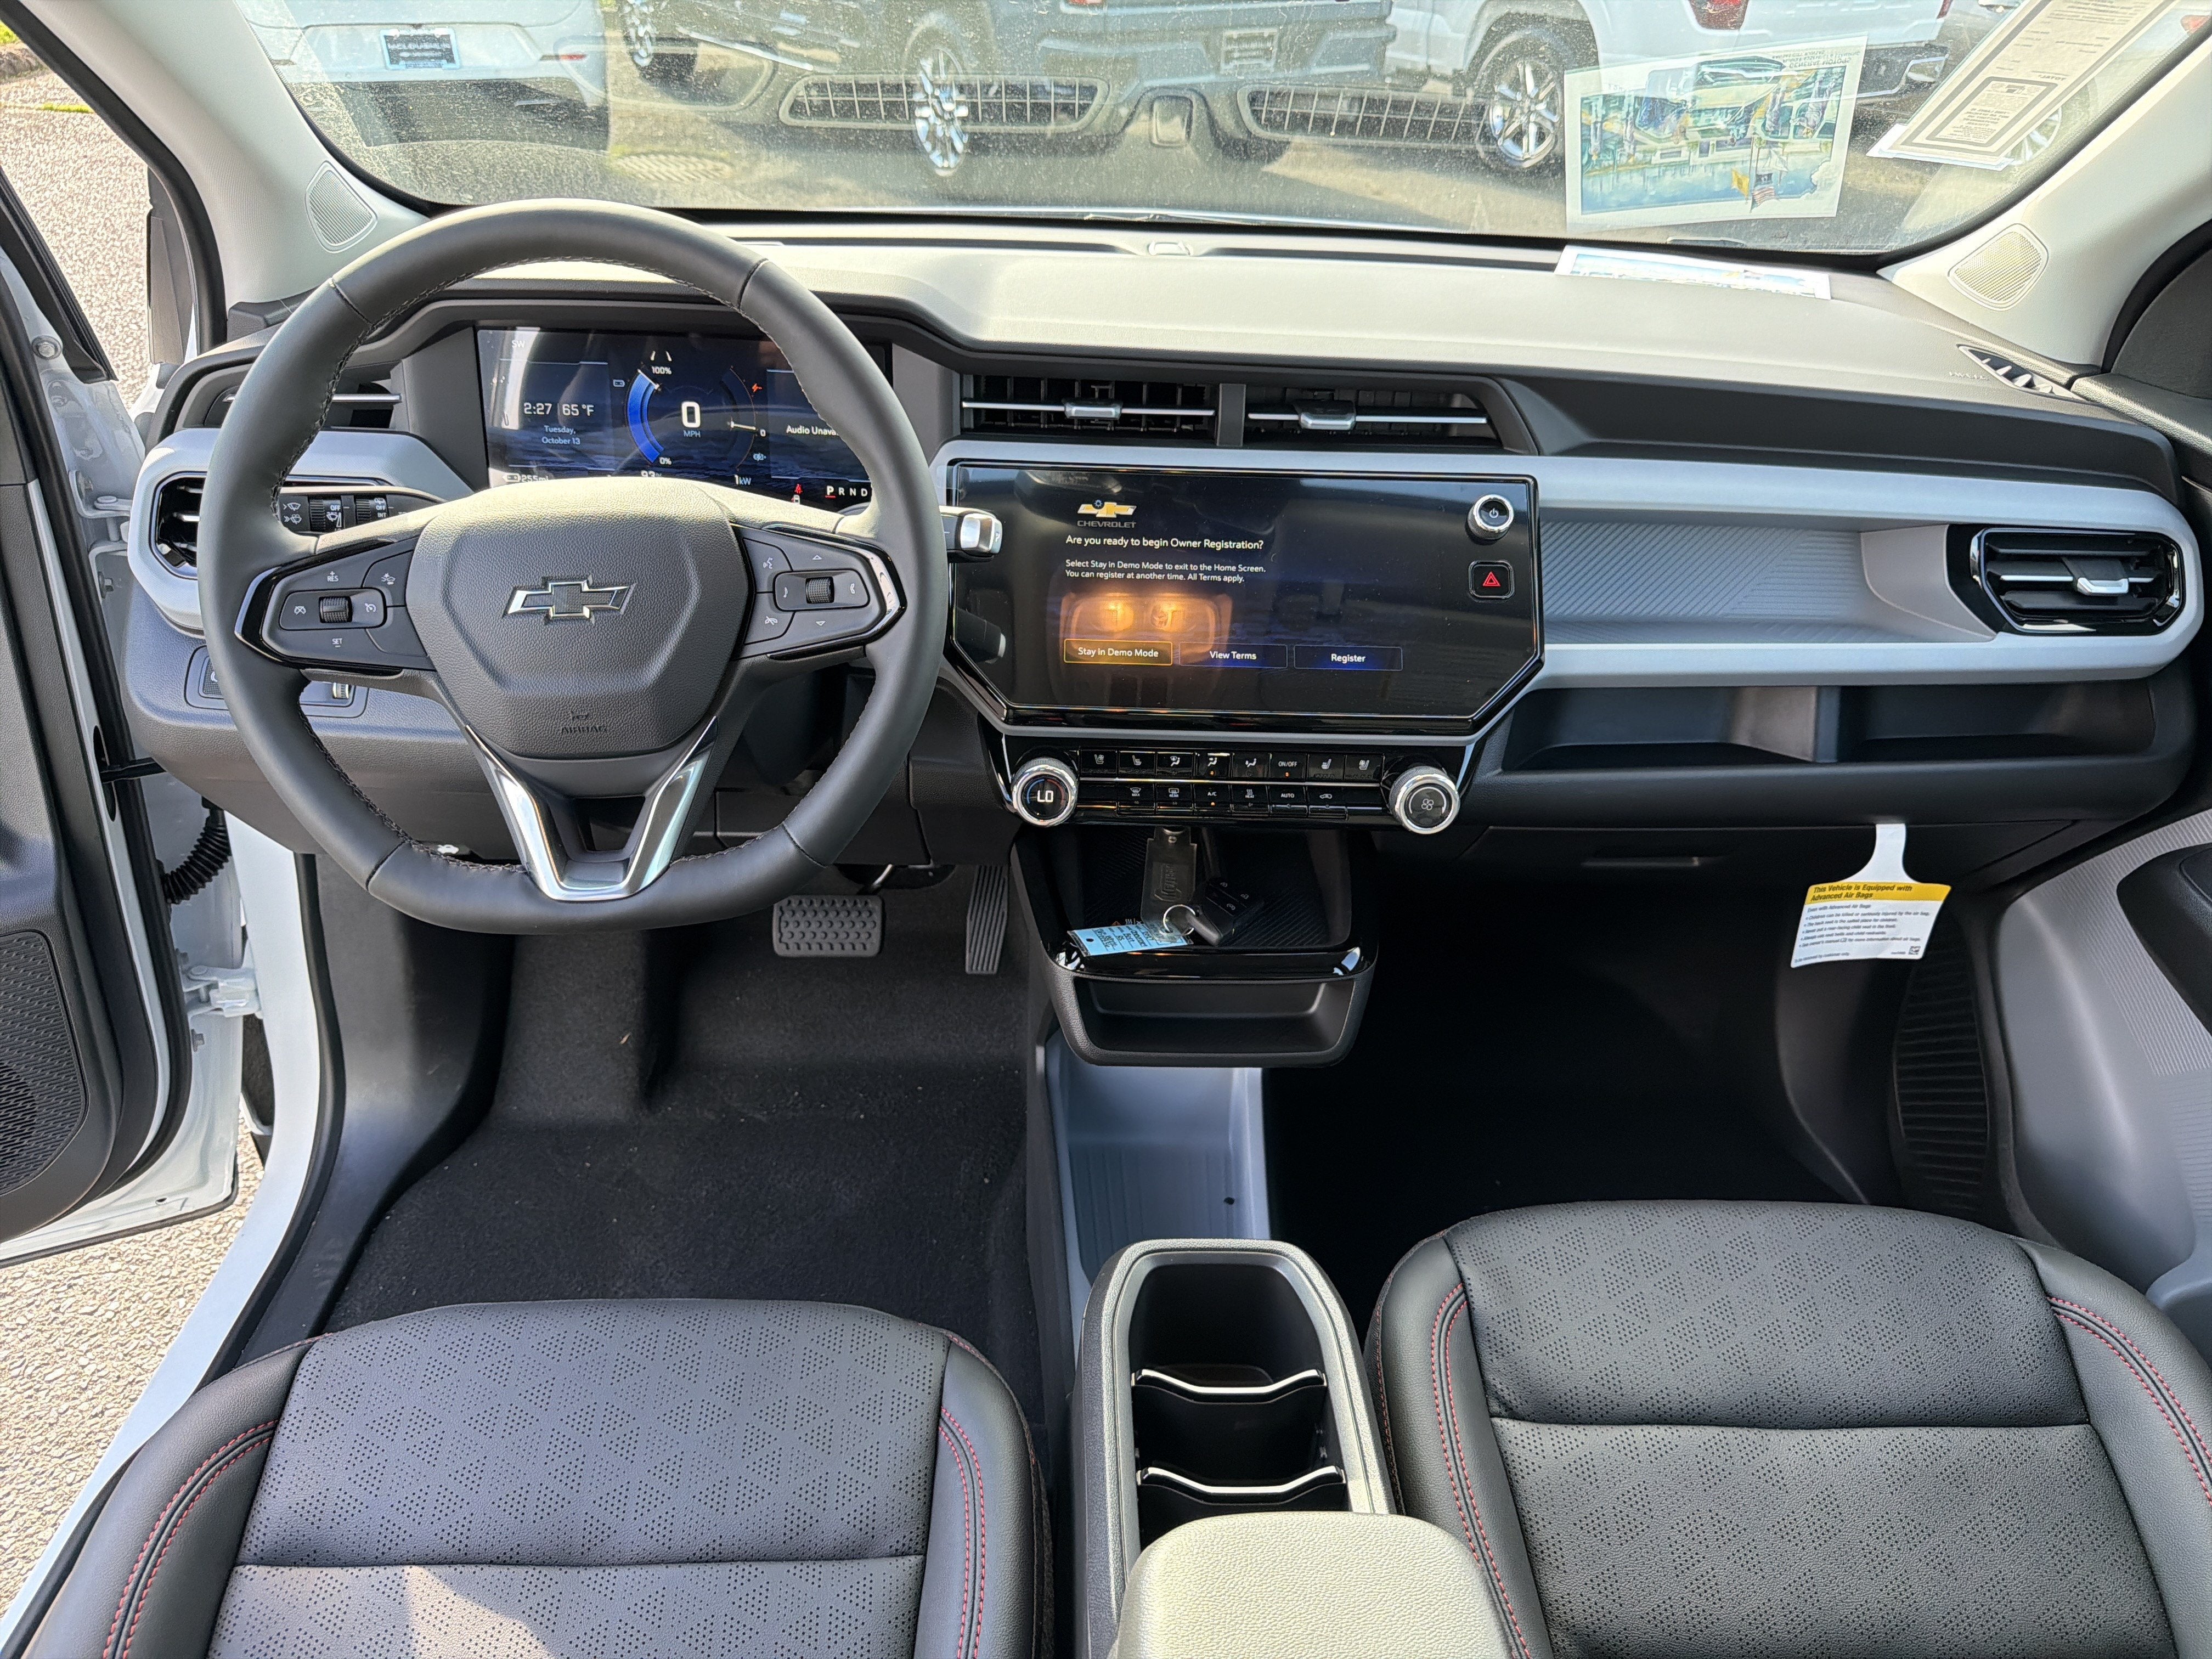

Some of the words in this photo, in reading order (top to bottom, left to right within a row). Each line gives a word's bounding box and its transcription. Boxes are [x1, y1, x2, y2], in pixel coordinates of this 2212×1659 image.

[511, 340, 525, 348] SW
[651, 366, 672, 375] 100%
[523, 402, 552, 415] 2:27
[562, 404, 579, 416] 65
[582, 404, 594, 416] °F
[681, 401, 701, 428] 0
[544, 425, 576, 435] Tuesday,
[684, 430, 701, 438] MPH
[786, 425, 810, 435] Audio
[541, 437, 571, 445] October
[659, 457, 672, 465] 0%
[826, 486, 834, 495] P
[838, 487, 845, 496] R
[850, 488, 856, 496] N
[861, 488, 868, 496] D
[1077, 520, 1137, 528] CHEVROLET
[1065, 535, 1082, 544] Are
[1084, 537, 1101, 546] you
[1103, 537, 1128, 548] ready
[1131, 538, 1141, 546] to
[1142, 537, 1169, 549] begin
[1170, 538, 1201, 548] Owner
[1204, 539, 1264, 550] Registration?
[1065, 560, 1089, 568] Select
[1091, 560, 1107, 569] Stay
[1117, 561, 1140, 569] Demo
[1142, 562, 1163, 570] Mode
[1238, 564, 1266, 573] Screen.
[1065, 569, 1080, 578] You
[1096, 571, 1125, 580] register
[1167, 572, 1186, 580] time.
[1223, 574, 1245, 584] apply.
[1078, 647, 1096, 658] Stay
[1108, 648, 1133, 657] Demo
[1135, 648, 1159, 657] Mode
[1209, 650, 1230, 659] View
[1231, 651, 1257, 660] Terms
[1331, 653, 1366, 664] Register
[561, 725, 607, 735] AIRBAG
[1037, 789, 1054, 803] LO
[1829, 884, 1853, 892] Vehicle
[1811, 892, 1843, 901] Advanced
